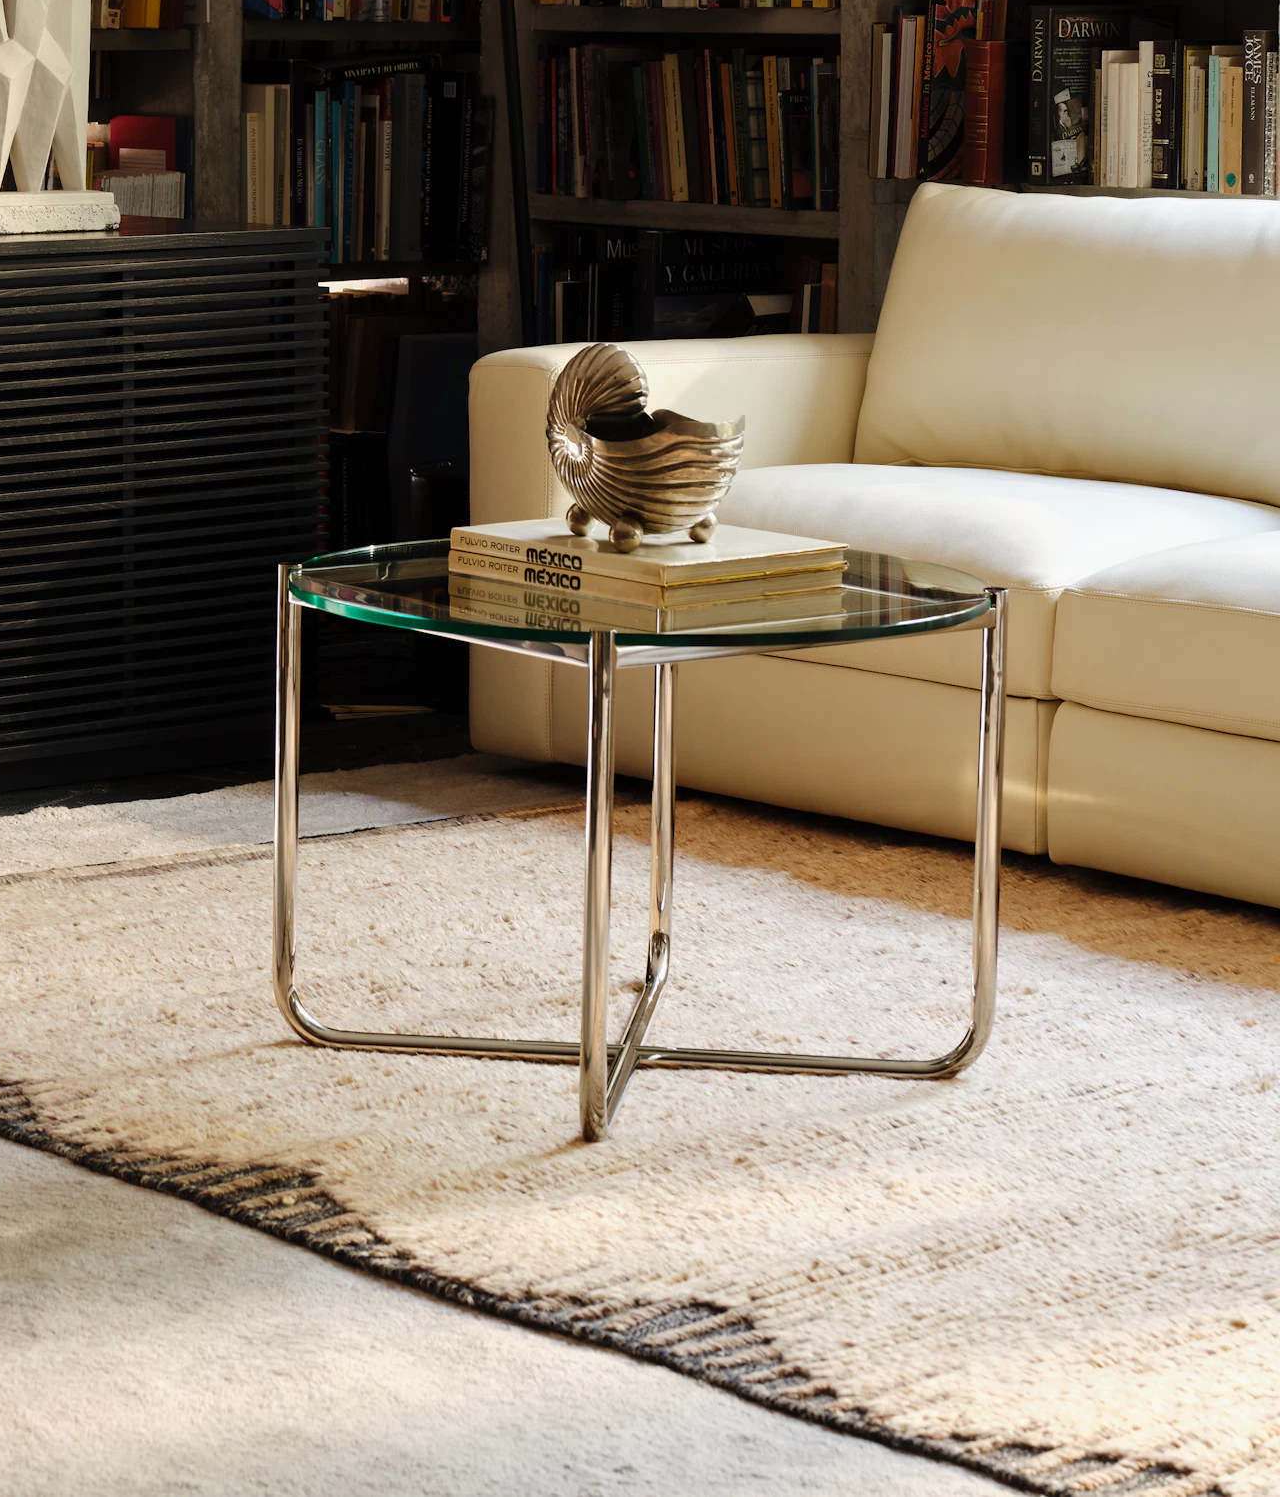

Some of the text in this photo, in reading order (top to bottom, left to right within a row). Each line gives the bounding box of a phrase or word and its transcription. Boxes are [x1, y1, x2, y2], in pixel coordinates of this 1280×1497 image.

[1031, 19, 1044, 83] DARWIN
[1056, 17, 1121, 39] DARWIN
[1244, 35, 1252, 83] JOYCE
[1252, 35, 1261, 85] JAMES
[1154, 89, 1163, 125] JOYCE
[316, 139, 325, 185] GLASS
[384, 123, 392, 171] EL MOSAICO
[457, 555, 581, 591] FULVIO ROITER MÉXICO
[459, 535, 582, 571] FULVIO ROITER MÉXICO
